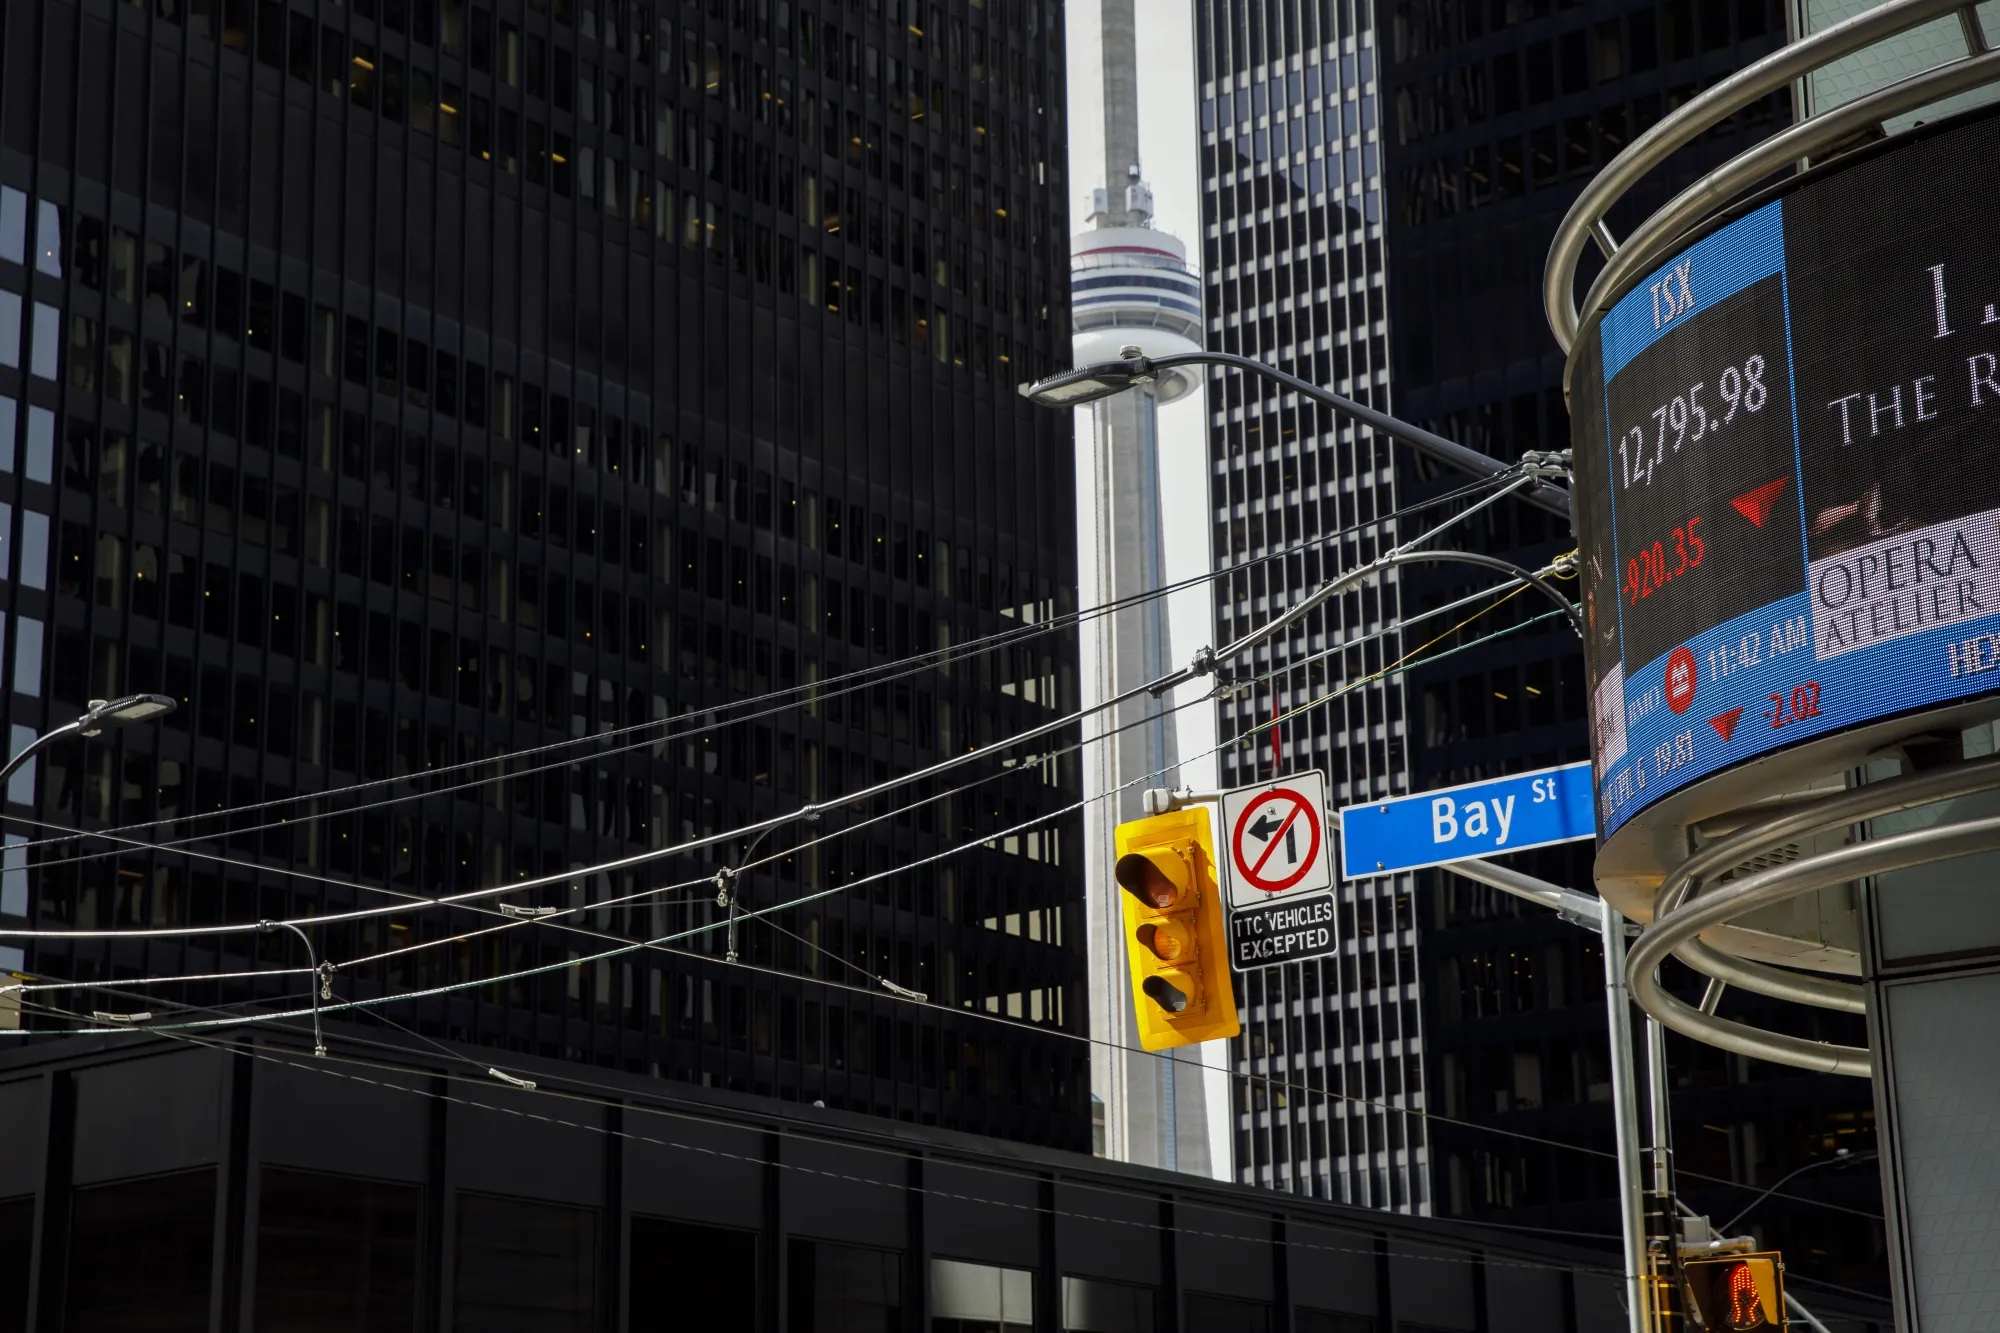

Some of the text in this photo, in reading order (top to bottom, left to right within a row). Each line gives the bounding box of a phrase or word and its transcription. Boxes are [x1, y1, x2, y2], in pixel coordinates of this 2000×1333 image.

[1649, 259, 1696, 330] TSX
[1618, 354, 1767, 490] 12,795.98
[1827, 374, 1938, 447] THE
[1623, 516, 1705, 605] -920.35
[1819, 530, 1981, 611] OPERA
[1707, 616, 1808, 681] 11:42 AM
[1826, 578, 1984, 651] ATELIER
[1763, 680, 1823, 729] -2.02
[1432, 777, 1558, 846] Bay St
[1235, 901, 1333, 937] TTC VEHICLES
[1240, 926, 1330, 962] EXCEPTED
